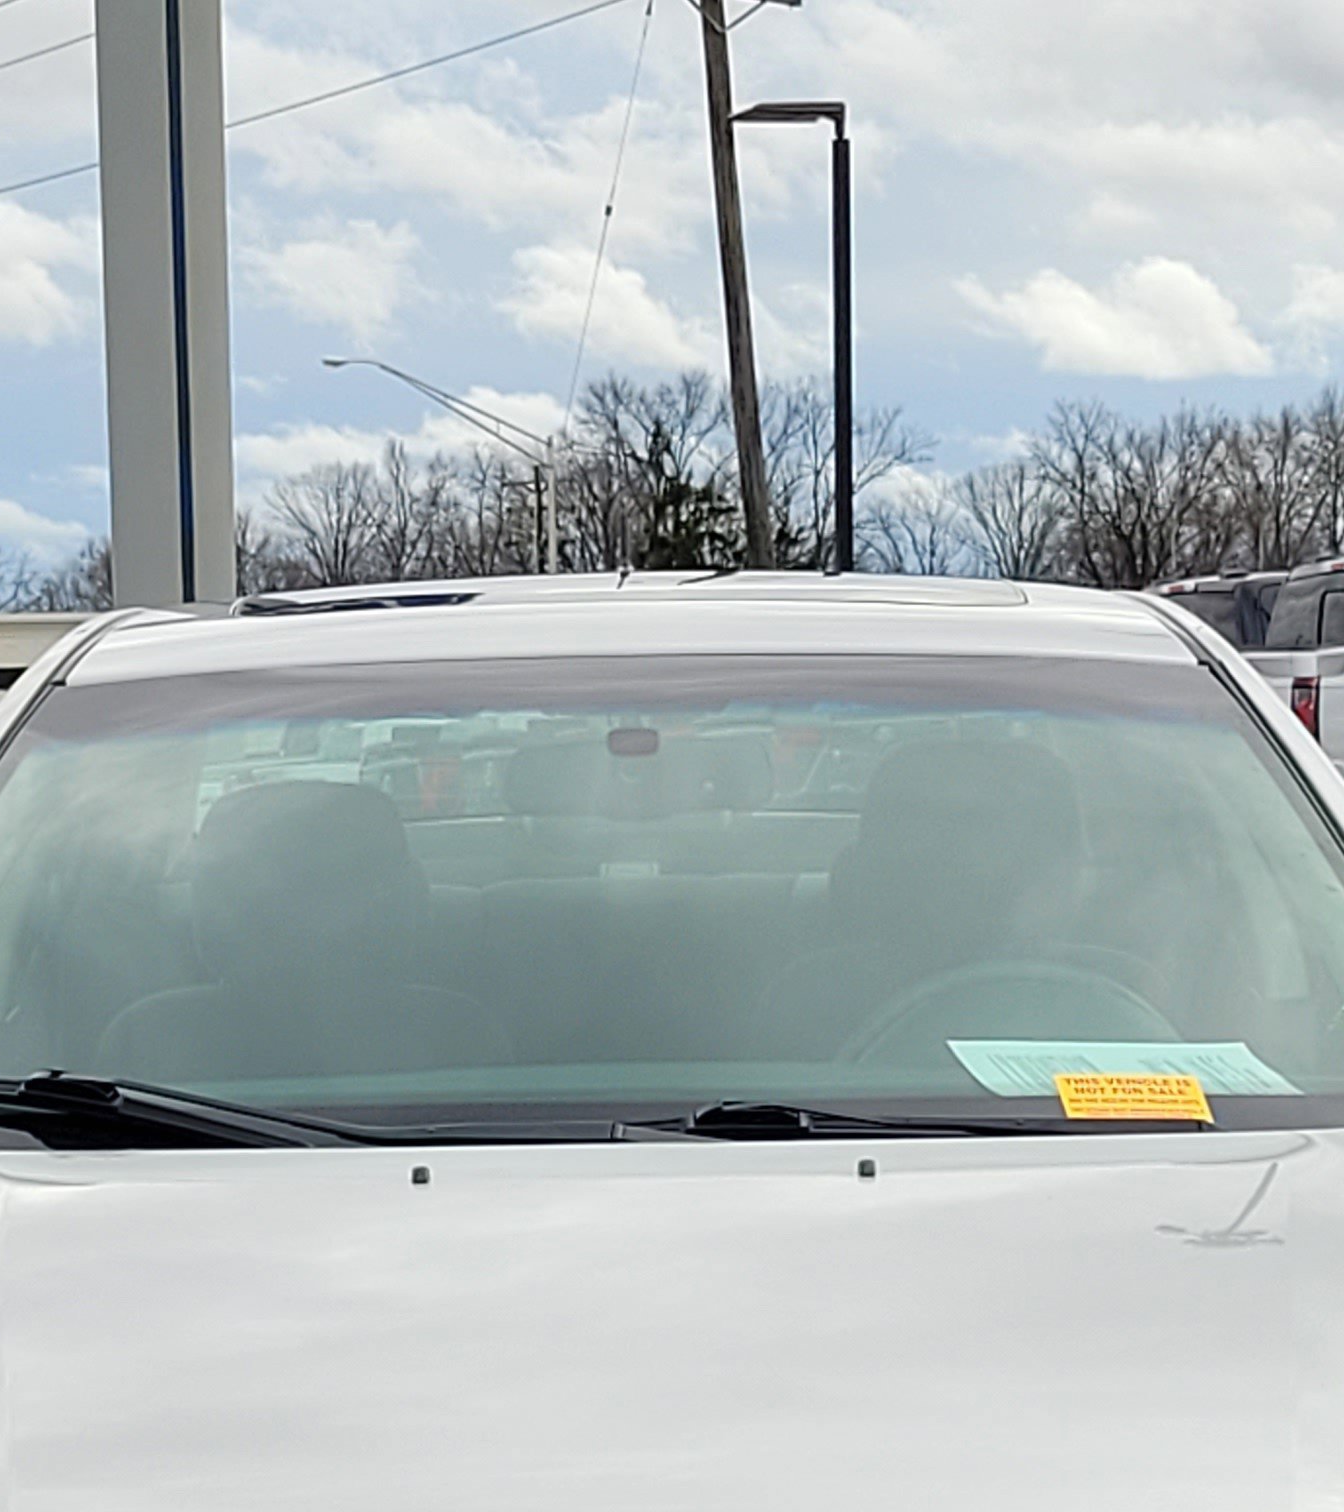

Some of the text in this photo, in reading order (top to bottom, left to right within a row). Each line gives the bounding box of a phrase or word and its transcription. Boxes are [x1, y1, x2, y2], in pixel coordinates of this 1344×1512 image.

[1105, 1077, 1172, 1087] VEHICLE
[1176, 1077, 1192, 1087] IS
[1072, 1087, 1188, 1096] NOT FOR SALE
